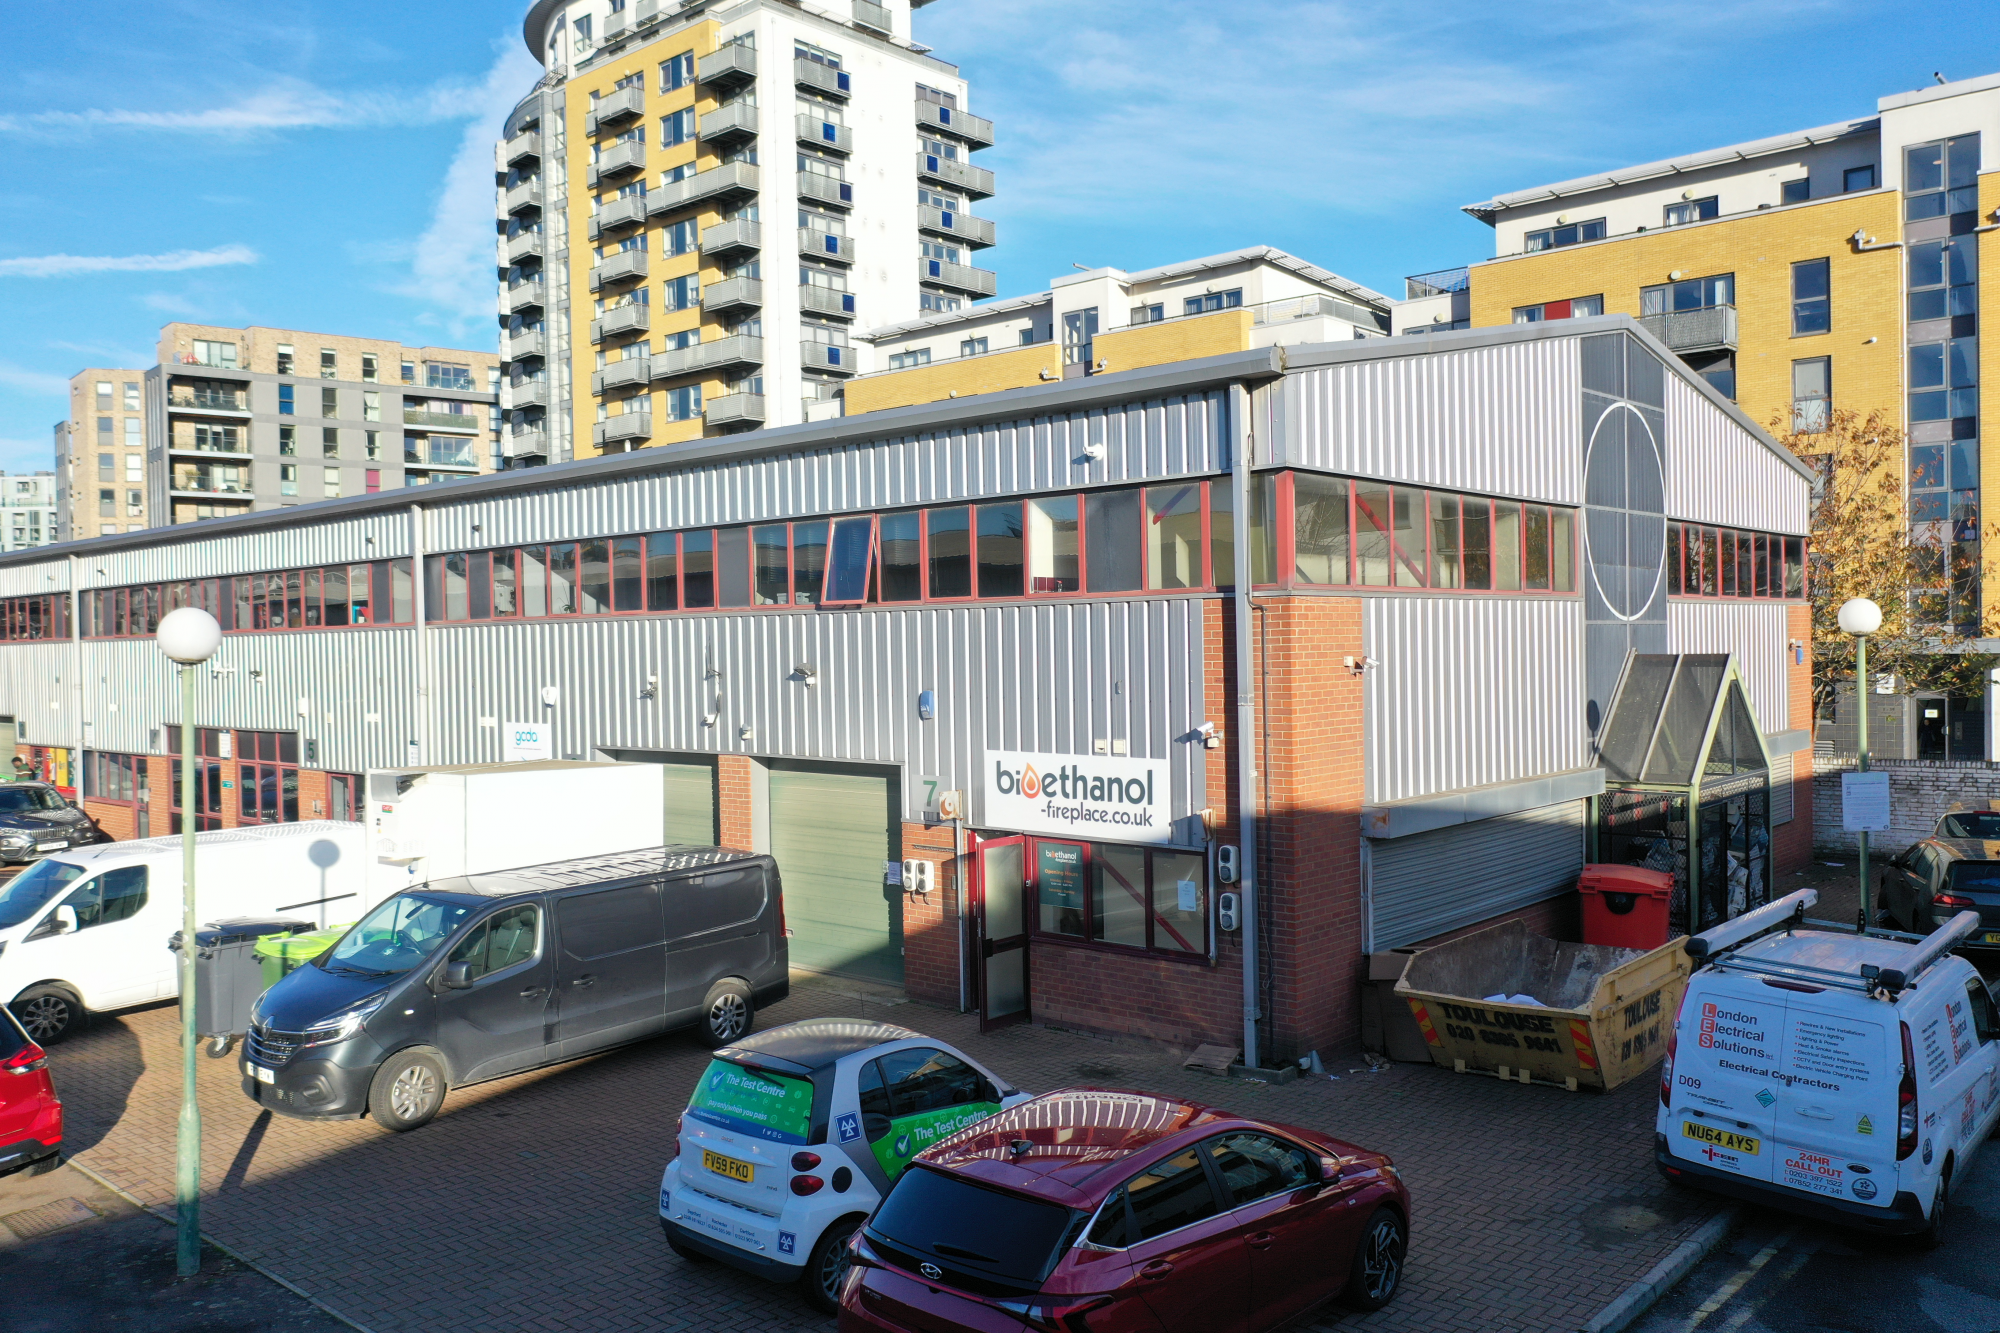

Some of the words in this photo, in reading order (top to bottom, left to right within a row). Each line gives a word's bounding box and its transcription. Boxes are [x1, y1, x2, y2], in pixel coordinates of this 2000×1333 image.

[308, 742, 315, 759] 5
[996, 760, 1153, 805] bioethanol
[923, 780, 937, 807] 7
[1041, 800, 1153, 827] -fireplace.co.uk
[1045, 849, 1077, 860] bioethanol
[1044, 868, 1064, 876] Opening
[1437, 1001, 1555, 1033] TOULOUSE
[1703, 1003, 1757, 1026] London
[1446, 1023, 1476, 1040] 020
[1701, 1018, 1764, 1042] Electrical
[1799, 1028, 1826, 1037] Emergency
[1699, 1033, 1765, 1058] Solutions
[1815, 1045, 1832, 1053] Smoke
[1798, 1050, 1819, 1058] Electrical
[1820, 1053, 1835, 1061] Safety
[1837, 1057, 1865, 1066] Inspections
[1719, 1059, 1768, 1076] Electrical
[1771, 1070, 1840, 1091] Contractors
[1833, 1070, 1854, 1080] Charging
[726, 1073, 740, 1086] The
[740, 1078, 756, 1092] Test
[757, 1081, 785, 1098] Centre
[1686, 1091, 1725, 1104] TRANSIT
[708, 1099, 718, 1108] pay
[718, 1101, 728, 1111] only
[742, 1109, 753, 1117] you
[753, 1111, 768, 1121] pass
[914, 1127, 934, 1141] The
[934, 1120, 955, 1135] Test
[956, 1110, 988, 1128] Centre
[1688, 1123, 1722, 1143] NU64
[1726, 1134, 1754, 1152] AYS
[705, 1153, 727, 1172] FV59
[1785, 1159, 1814, 1172] CALL
[1818, 1166, 1843, 1178] OUT
[1799, 1152, 1830, 1166] 24HR
[1809, 1175, 1823, 1183] 397
[1826, 1179, 1843, 1187] 1522
[1813, 1183, 1827, 1191] 277
[1830, 1187, 1843, 1195] 341
